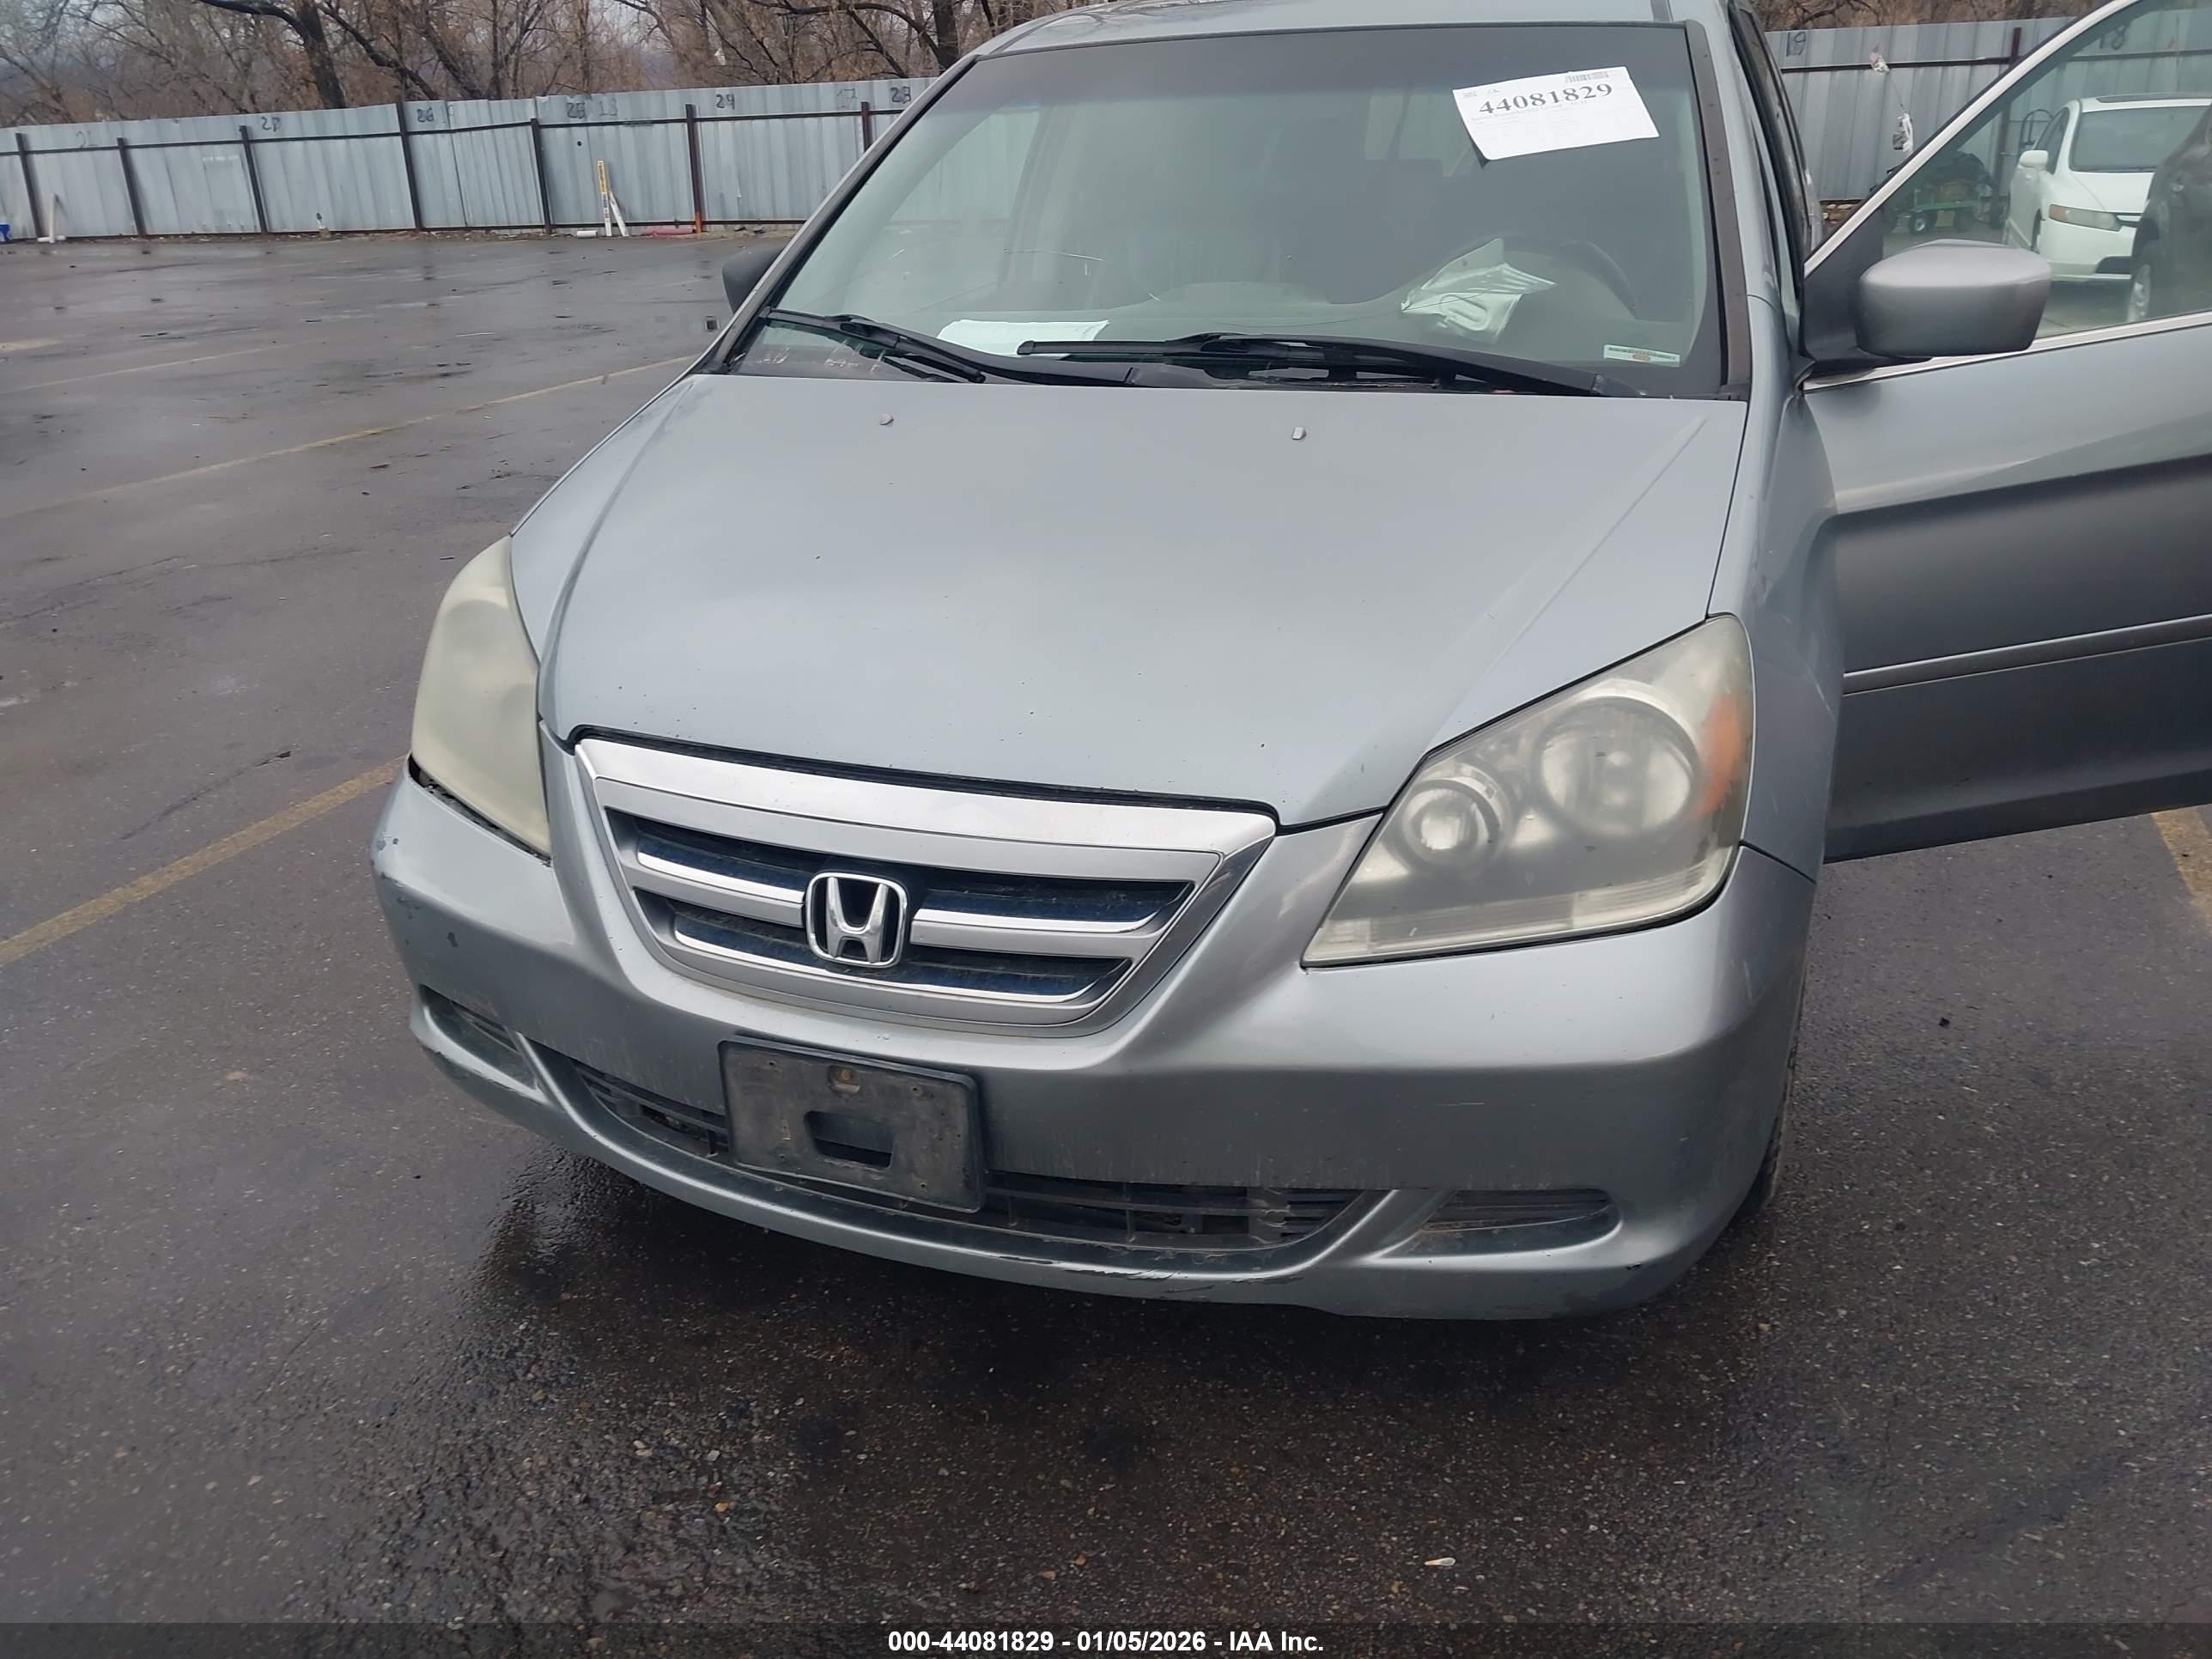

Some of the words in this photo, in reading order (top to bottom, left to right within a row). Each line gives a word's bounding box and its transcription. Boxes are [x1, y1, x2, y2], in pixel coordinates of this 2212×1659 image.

[1786, 31, 1807, 57] 19
[715, 94, 736, 110] 24
[1478, 83, 1613, 114] 44081829
